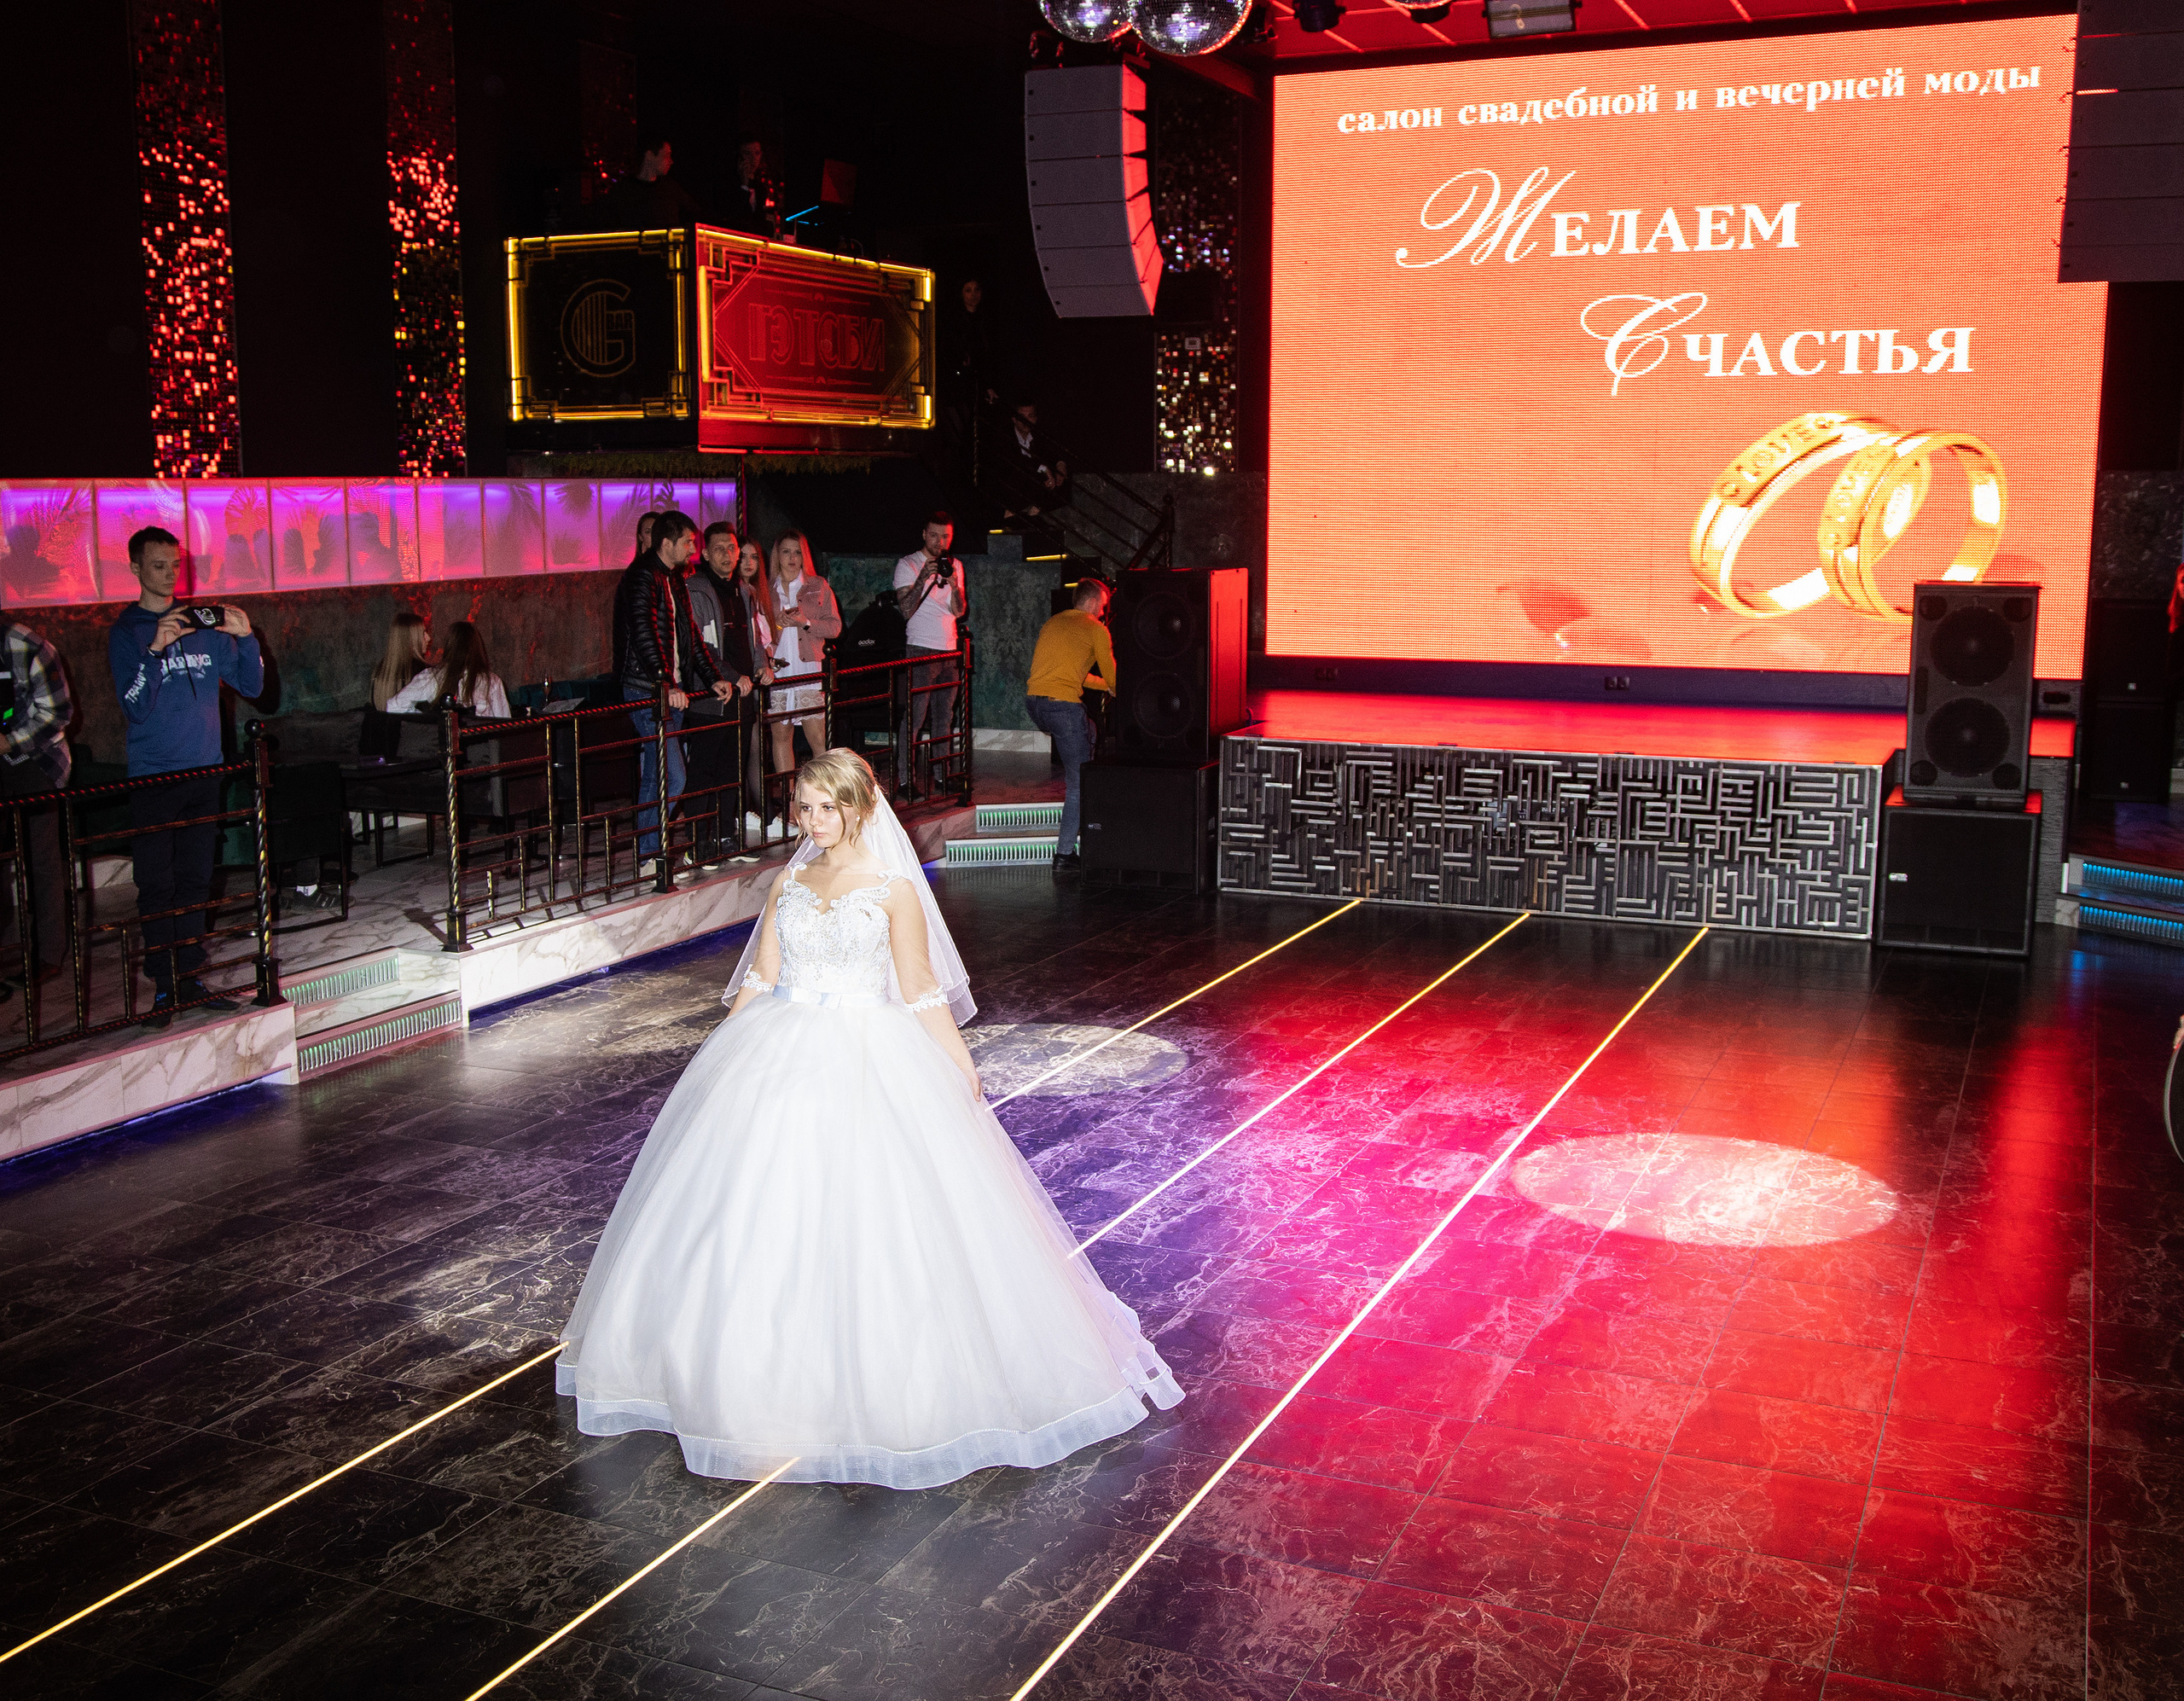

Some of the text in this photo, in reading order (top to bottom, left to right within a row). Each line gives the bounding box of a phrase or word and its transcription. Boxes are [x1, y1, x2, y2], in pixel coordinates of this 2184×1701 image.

[1338, 66, 2041, 133] салон свадебной и вечерней моды
[1396, 165, 1802, 269] ЖЕЛАЕМ
[748, 302, 886, 373] ГЭТСБИ
[1581, 292, 1975, 397] СЧАСТЬЯ
